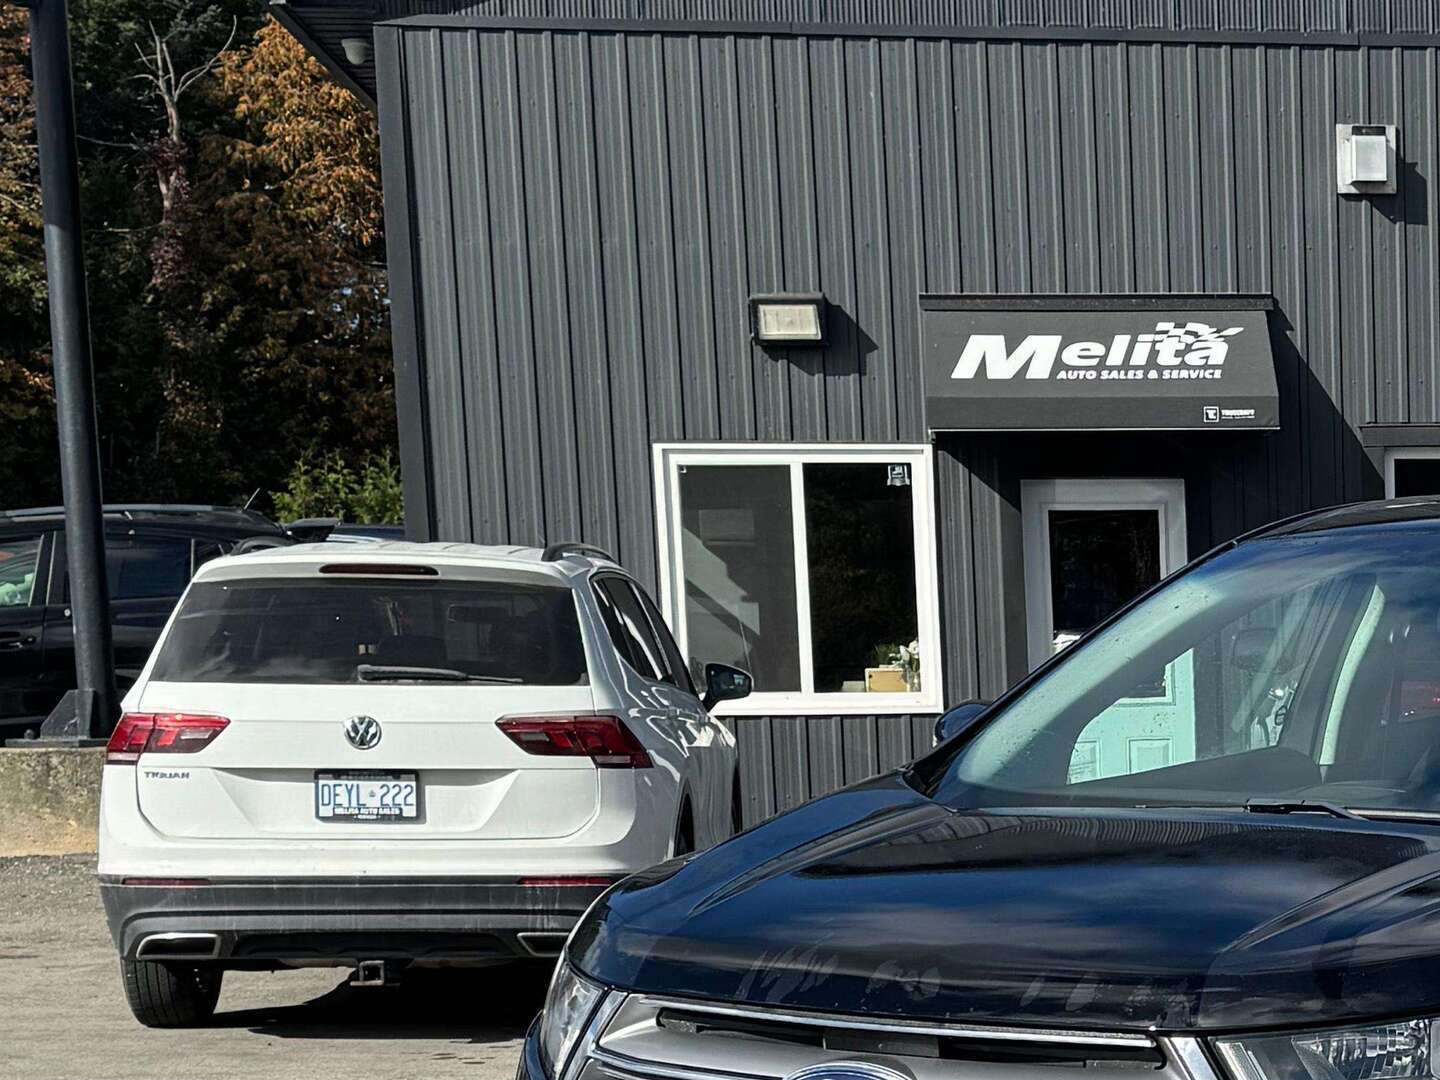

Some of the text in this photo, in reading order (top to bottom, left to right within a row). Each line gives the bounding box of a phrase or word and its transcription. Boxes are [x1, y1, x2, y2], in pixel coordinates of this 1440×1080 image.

[950, 333, 1229, 379] Melita
[1056, 369, 1222, 380] AUTO SALES & SERVICE
[321, 783, 414, 807] DEYL 222
